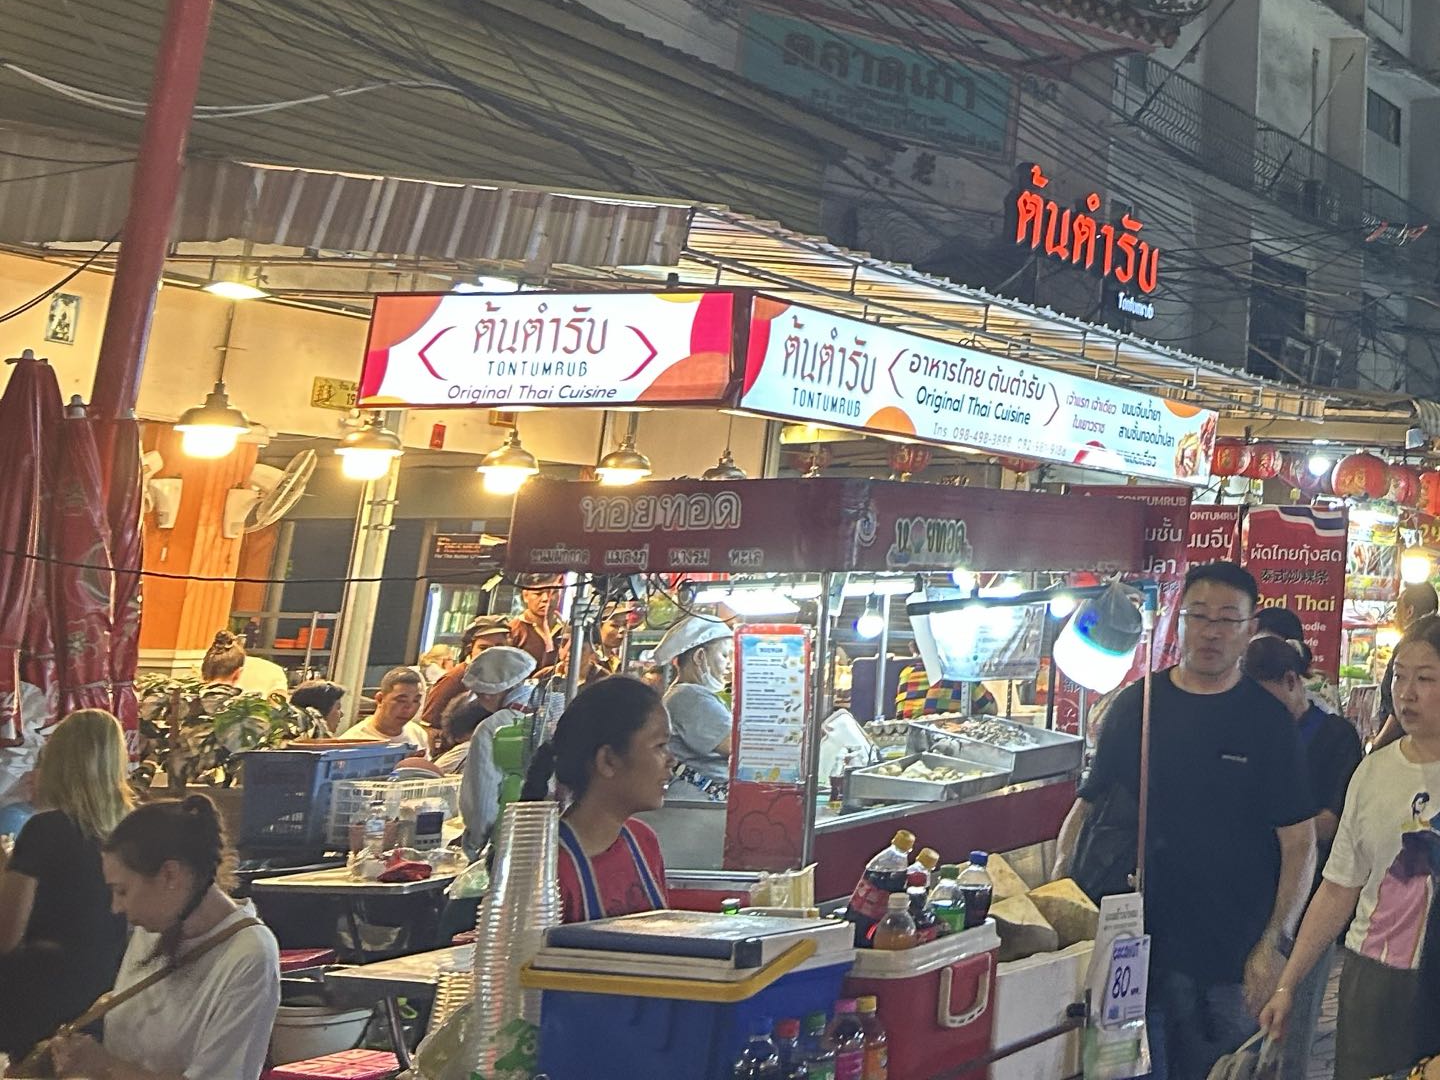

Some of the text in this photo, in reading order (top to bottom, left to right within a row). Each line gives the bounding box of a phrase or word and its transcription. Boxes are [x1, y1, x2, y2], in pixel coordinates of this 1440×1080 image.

[1016, 164, 1160, 294] ต้นตำรับ
[473, 301, 609, 354] ต้นตำรับ
[488, 360, 588, 376] TONTUMRUB
[781, 315, 877, 395] ต้นตำรับ
[908, 352, 1046, 401] อาหารไทย ต้นตำรับ
[447, 385, 617, 404] Original Thai Cuisine
[792, 387, 861, 418] TONTUMRUB
[916, 385, 1031, 425] Original Thai Cuisine
[580, 491, 742, 532] หอยทอด
[1117, 495, 1187, 507] UMRUB
[1250, 543, 1342, 566] ผัดไทยกุ้งสด
[1294, 594, 1336, 612] Thai
[1111, 965, 1132, 999] 80
